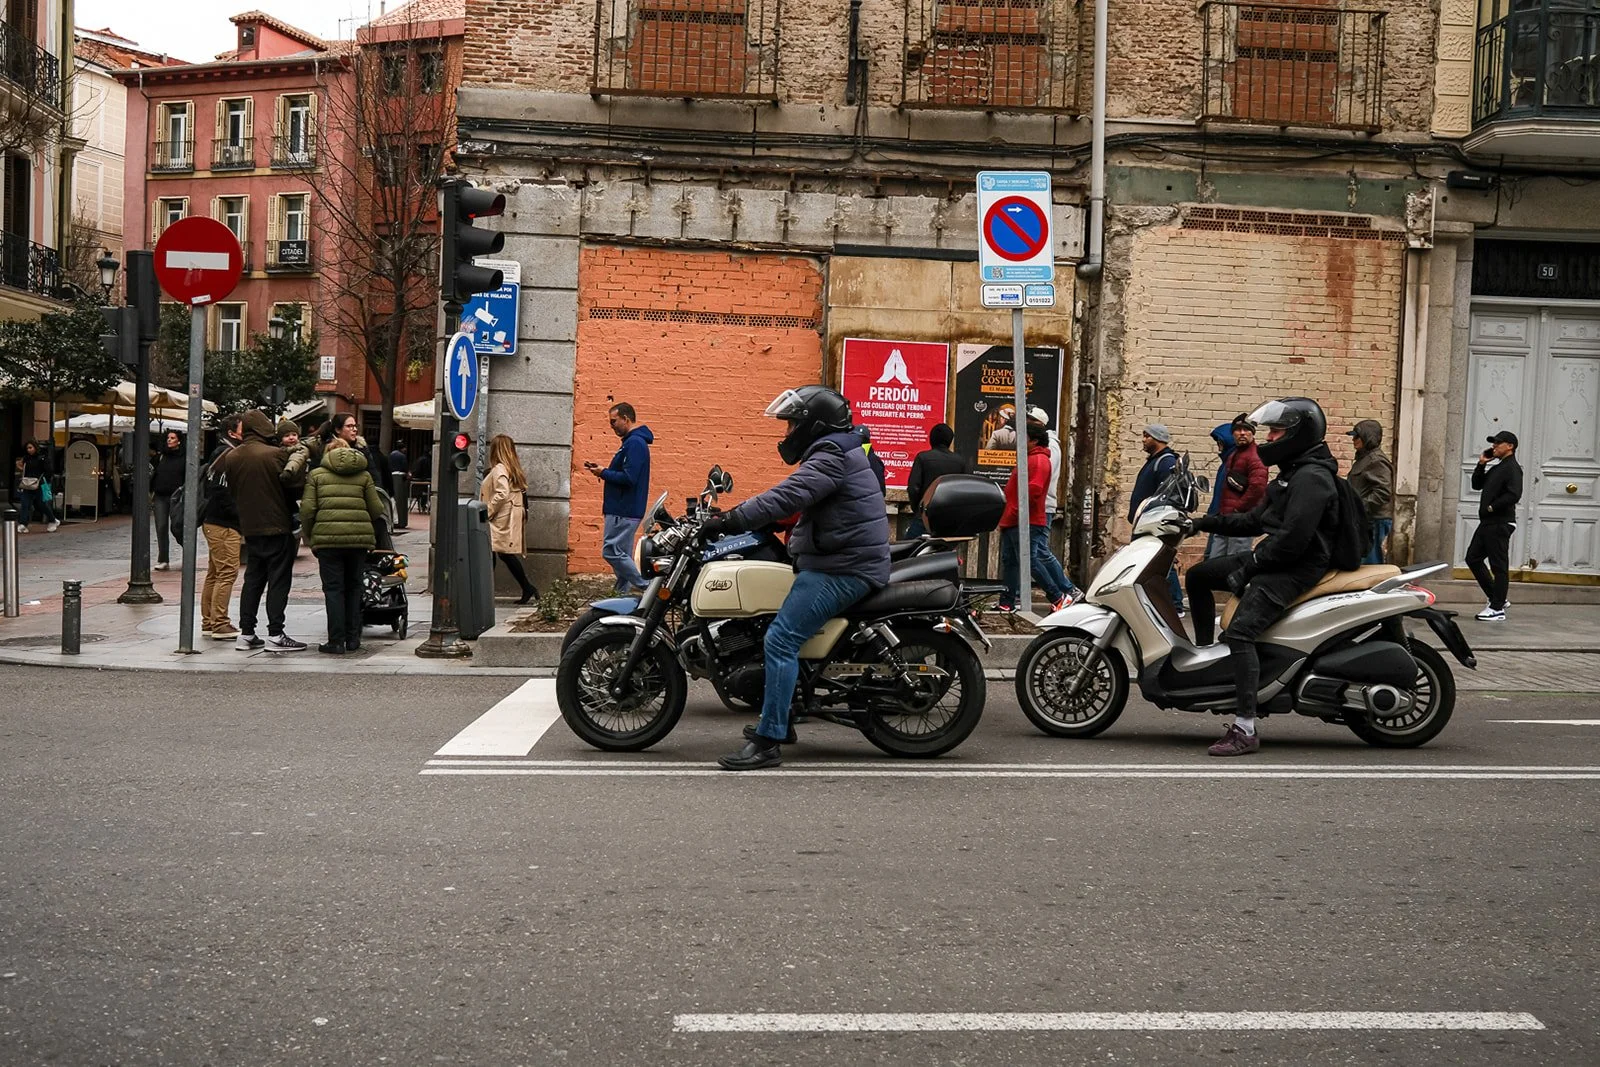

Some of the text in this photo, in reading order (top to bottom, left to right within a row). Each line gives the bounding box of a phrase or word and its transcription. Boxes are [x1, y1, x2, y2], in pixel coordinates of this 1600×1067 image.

[1542, 266, 1554, 276] 50
[982, 368, 1014, 377] TIEMPO
[981, 376, 1034, 386] COSTUS
[869, 386, 919, 402] PERDÓN
[871, 402, 895, 410] COLEGAS
[907, 403, 931, 411] TENDRÁN
